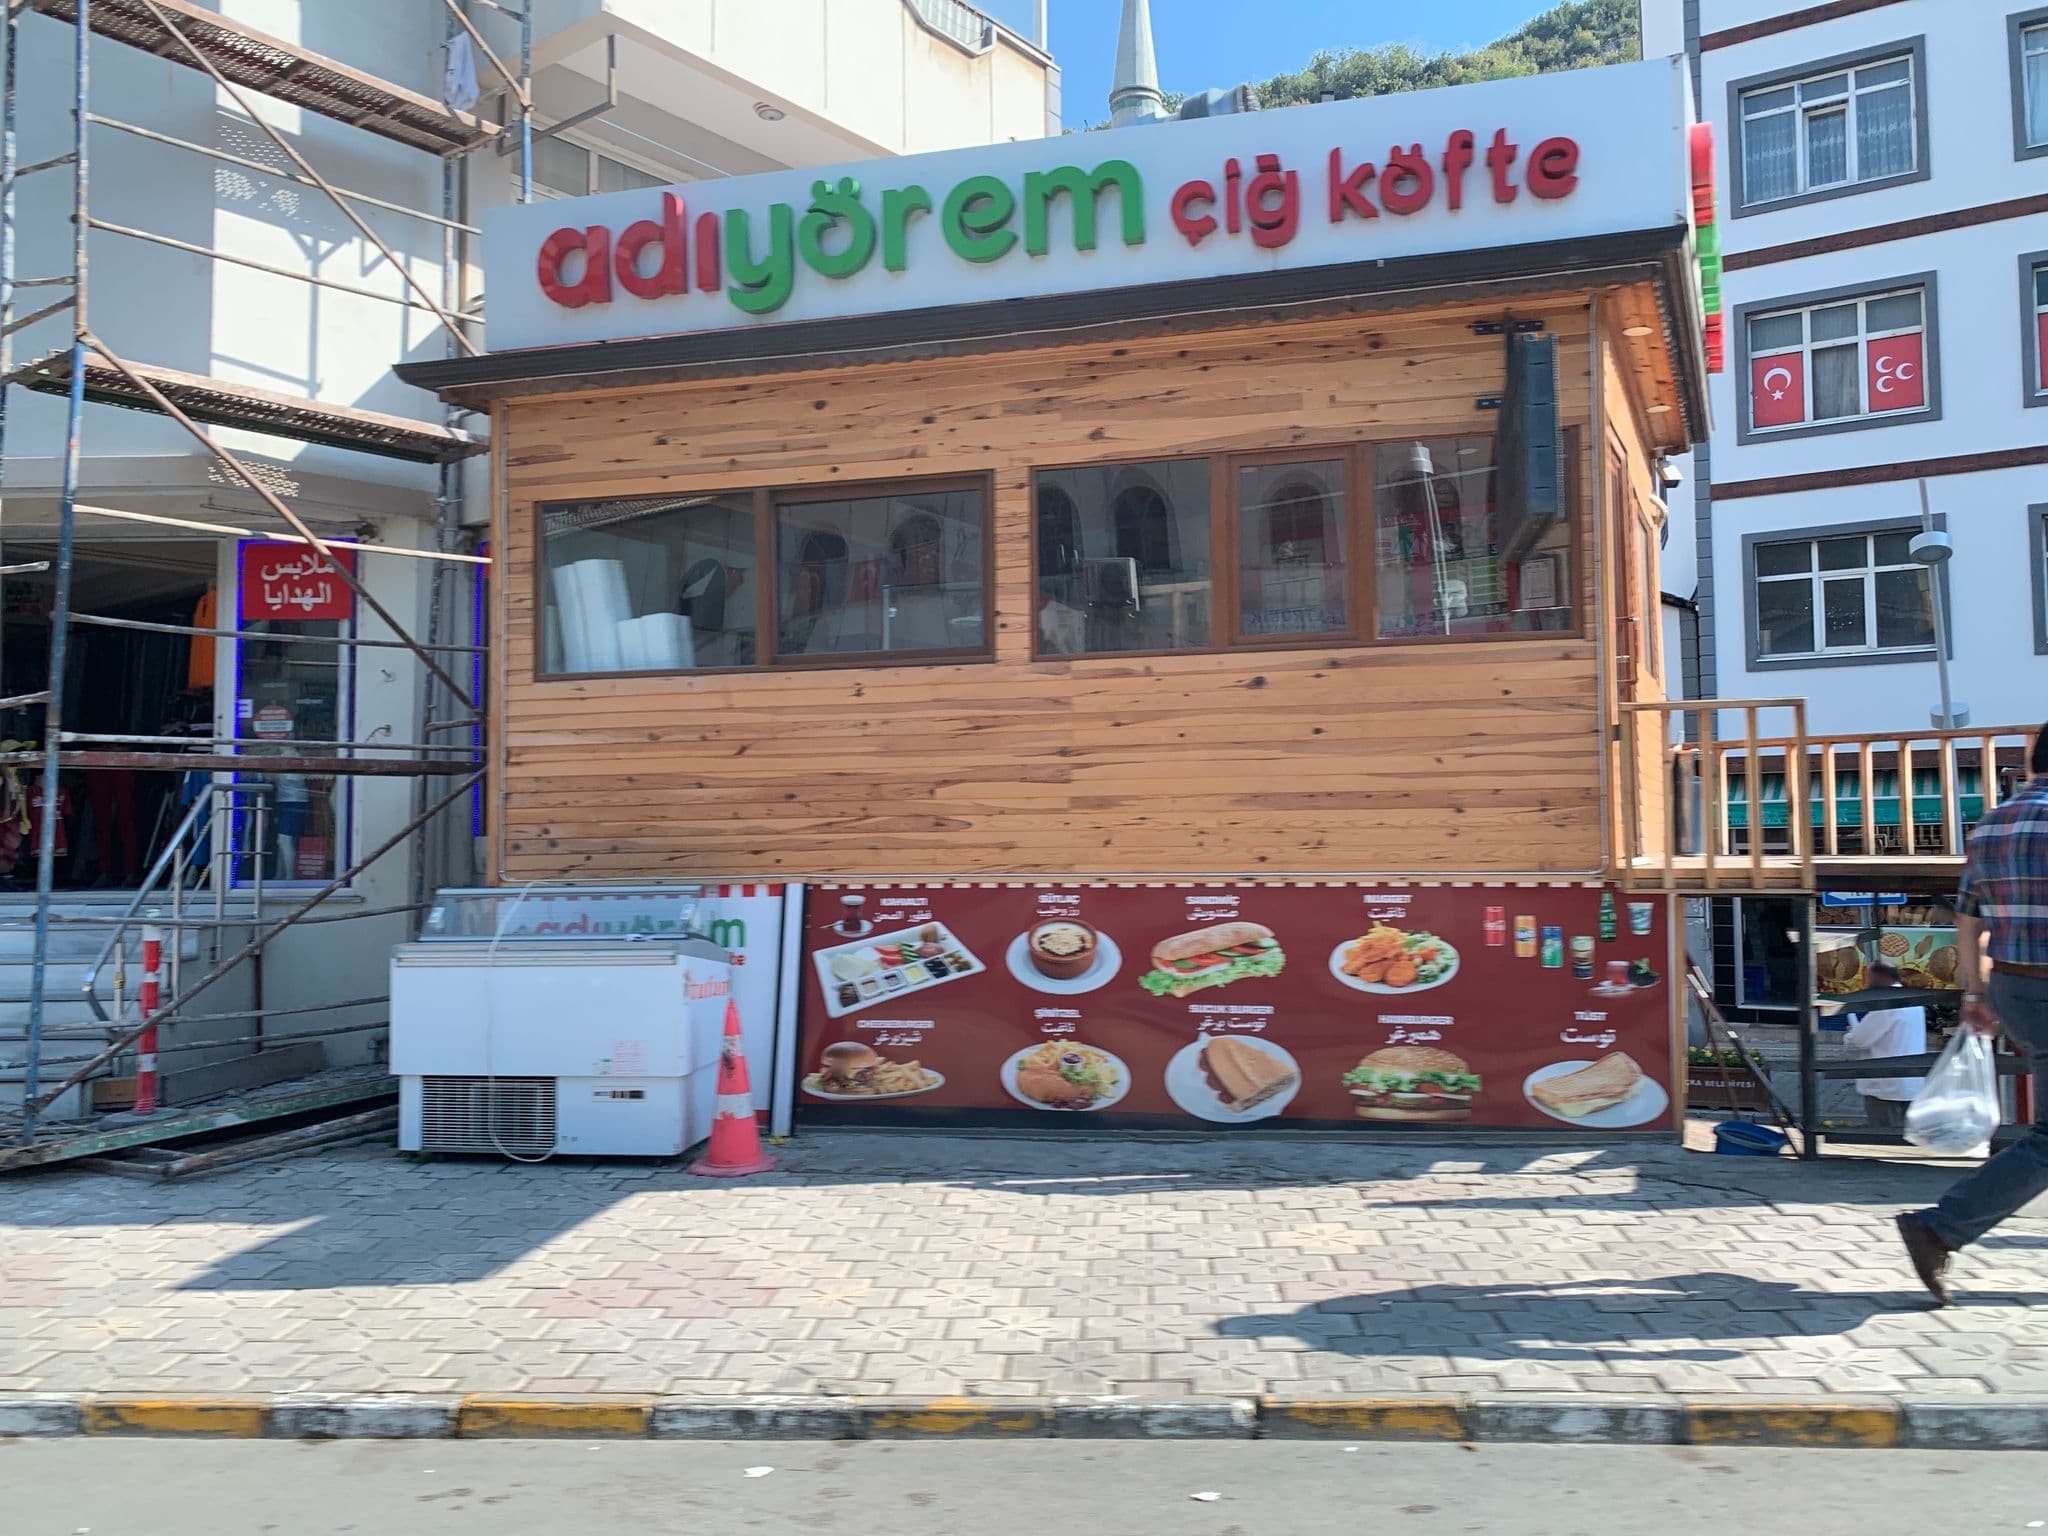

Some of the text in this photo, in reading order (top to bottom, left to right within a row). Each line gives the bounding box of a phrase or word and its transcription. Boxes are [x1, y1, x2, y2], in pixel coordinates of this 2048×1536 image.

[537, 128, 1580, 314] adıyörem çiğ köfte
[264, 582, 332, 611] الهدايا
[1559, 1027, 1617, 1048] توست
